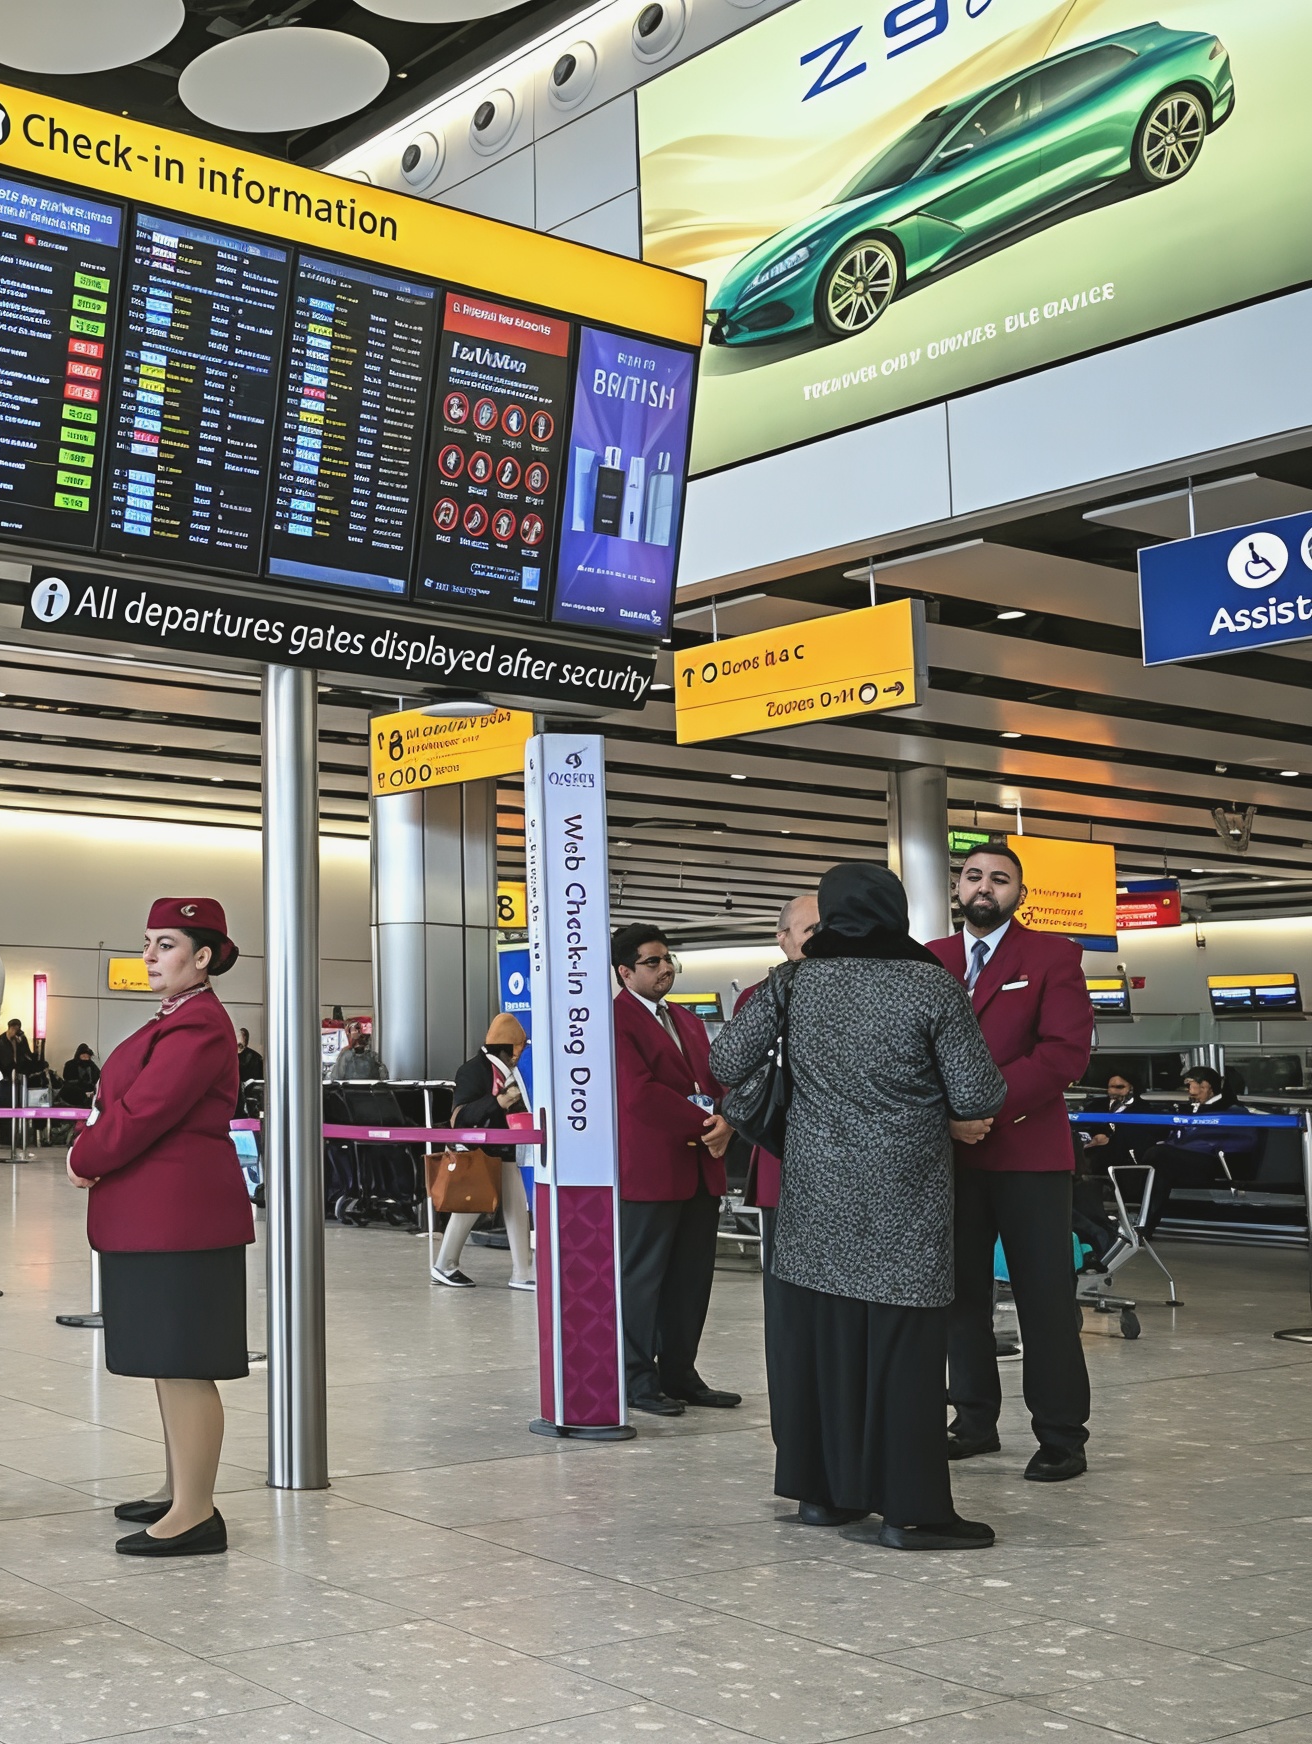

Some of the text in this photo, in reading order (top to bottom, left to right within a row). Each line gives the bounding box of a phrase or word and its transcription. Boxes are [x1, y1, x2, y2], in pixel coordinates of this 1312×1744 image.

[23, 113, 184, 184] Check-in
[198, 157, 398, 241] information
[74, 585, 651, 702] All departures gates displayed after security
[563, 813, 586, 871] Web
[566, 1066, 591, 1132] Drop
